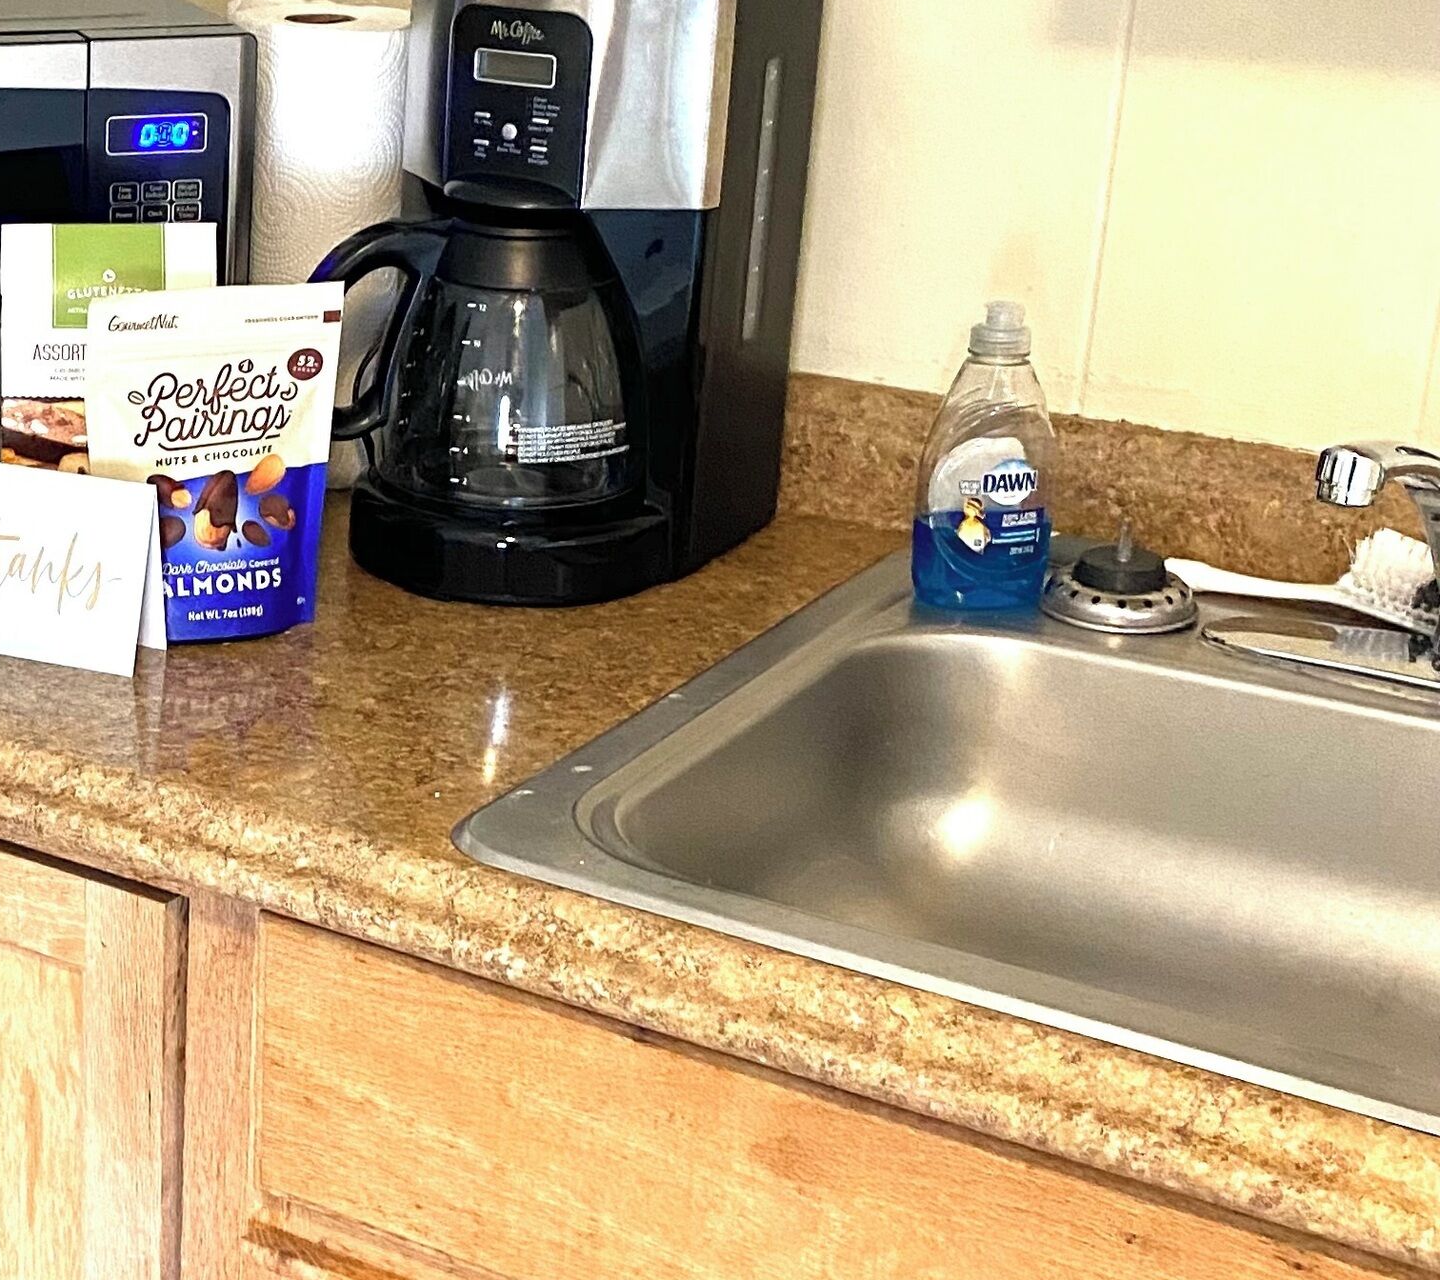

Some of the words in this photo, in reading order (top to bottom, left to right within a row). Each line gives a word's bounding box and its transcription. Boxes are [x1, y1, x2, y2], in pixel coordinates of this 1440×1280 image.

[144, 363, 281, 415] Perfect
[134, 404, 291, 448] Pairings
[155, 455, 187, 467] NUTS
[192, 455, 199, 463] &
[204, 445, 273, 462] CHOCOLATE
[982, 472, 1037, 494] DAWN
[162, 562, 194, 576] Dark
[195, 558, 247, 575] Chocolate
[162, 568, 282, 599] ALMONDS
